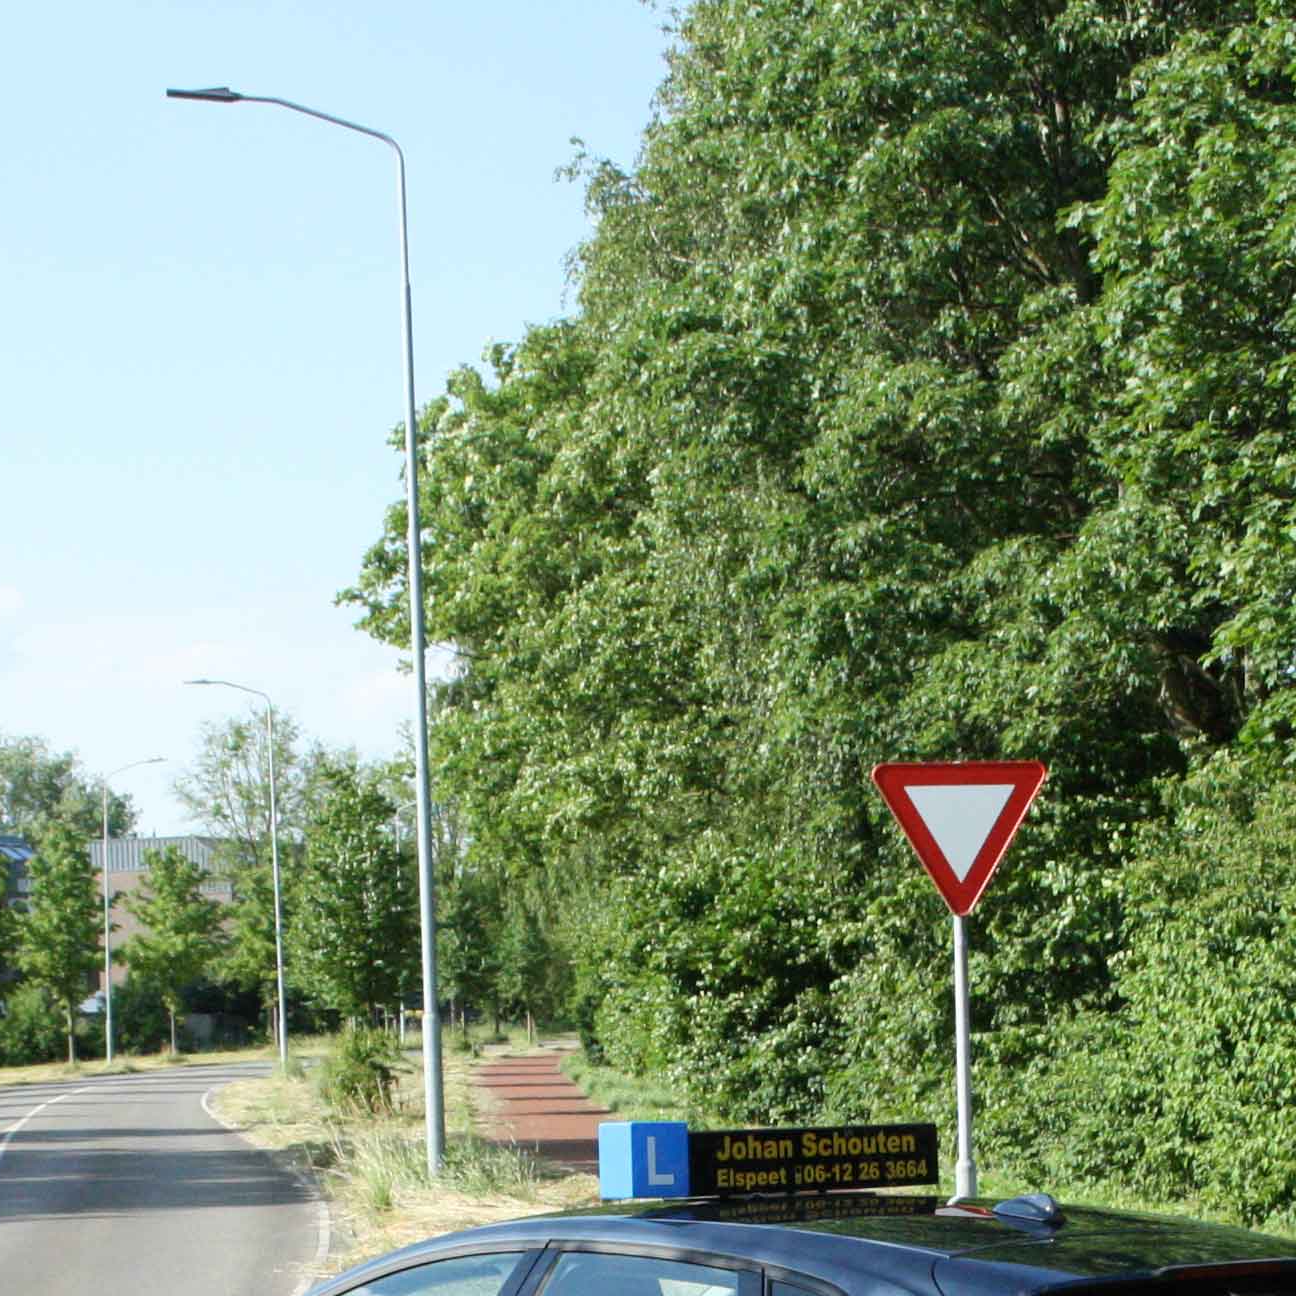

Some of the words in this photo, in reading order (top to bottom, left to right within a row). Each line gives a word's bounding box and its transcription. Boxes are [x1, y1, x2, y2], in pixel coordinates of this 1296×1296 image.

[646, 1135, 674, 1186] L
[716, 1135, 793, 1161] Johan
[801, 1131, 916, 1158] Schouten
[716, 1166, 787, 1190] Elspeet
[803, 1162, 853, 1183] 06-12
[858, 1162, 880, 1180] 26
[885, 1159, 928, 1179] 3664
